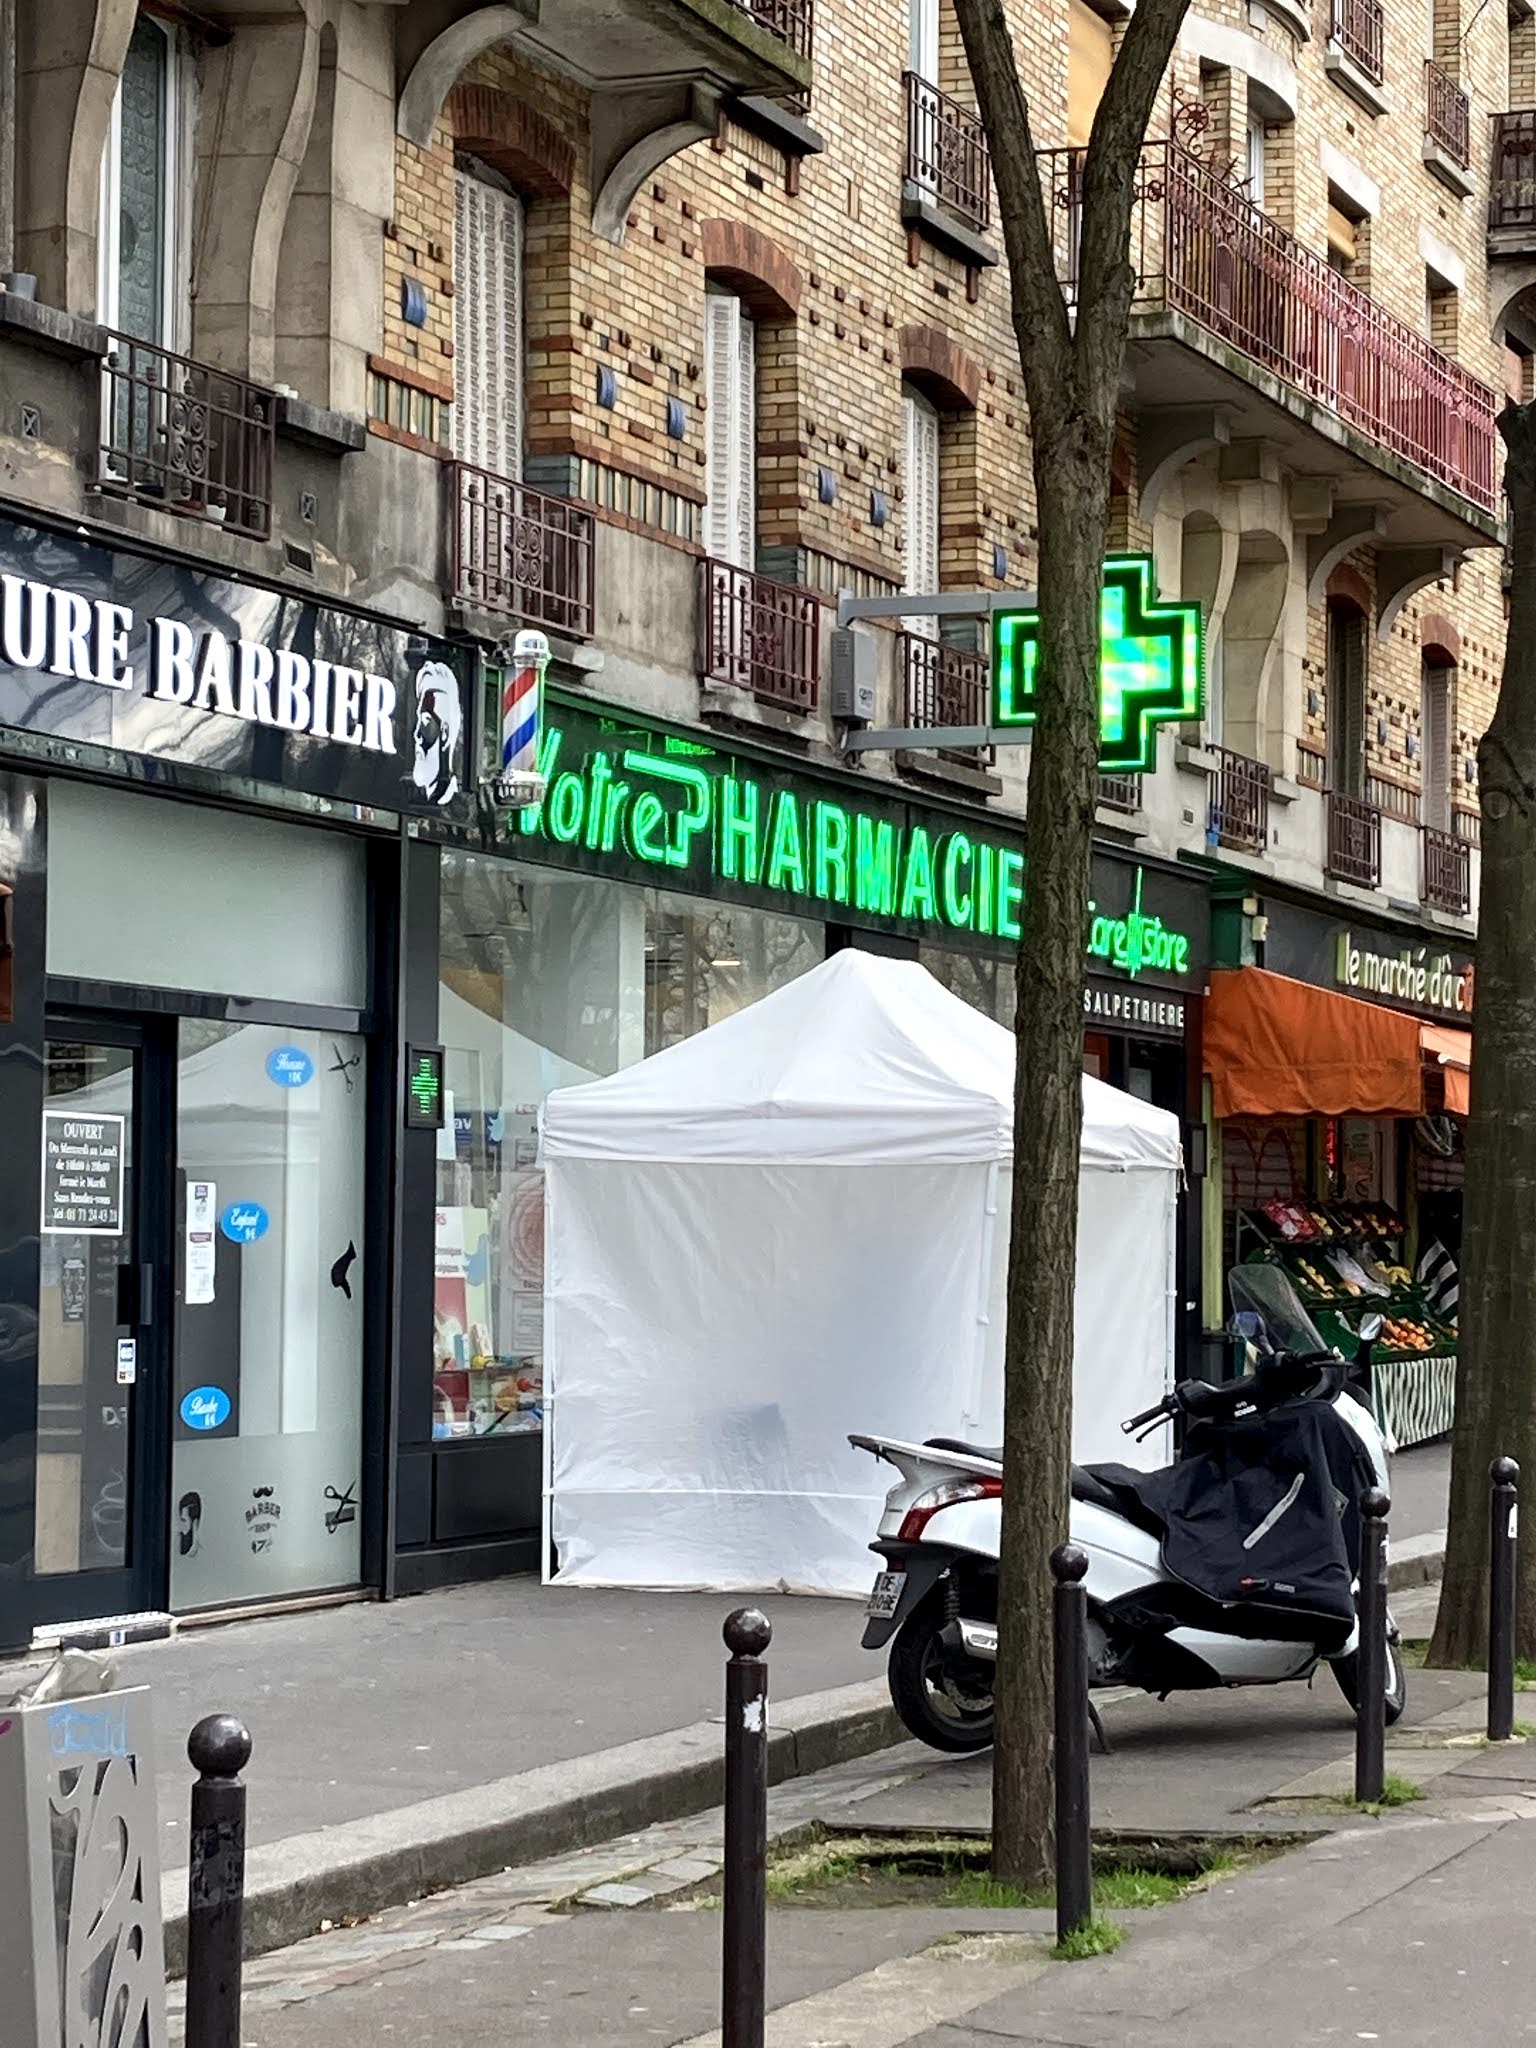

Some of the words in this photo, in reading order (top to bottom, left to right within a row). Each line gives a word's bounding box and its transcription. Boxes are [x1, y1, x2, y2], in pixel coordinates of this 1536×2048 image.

[152, 616, 397, 754] BARBIER
[518, 727, 664, 864] Votre
[624, 750, 1024, 939] PHARMACIE
[1343, 931, 1360, 986] le
[1364, 947, 1427, 1002] marché
[1083, 988, 1185, 1028] SALPETRIERE
[64, 1123, 104, 1139] OUVERT
[245, 1501, 281, 1524] BARBER
